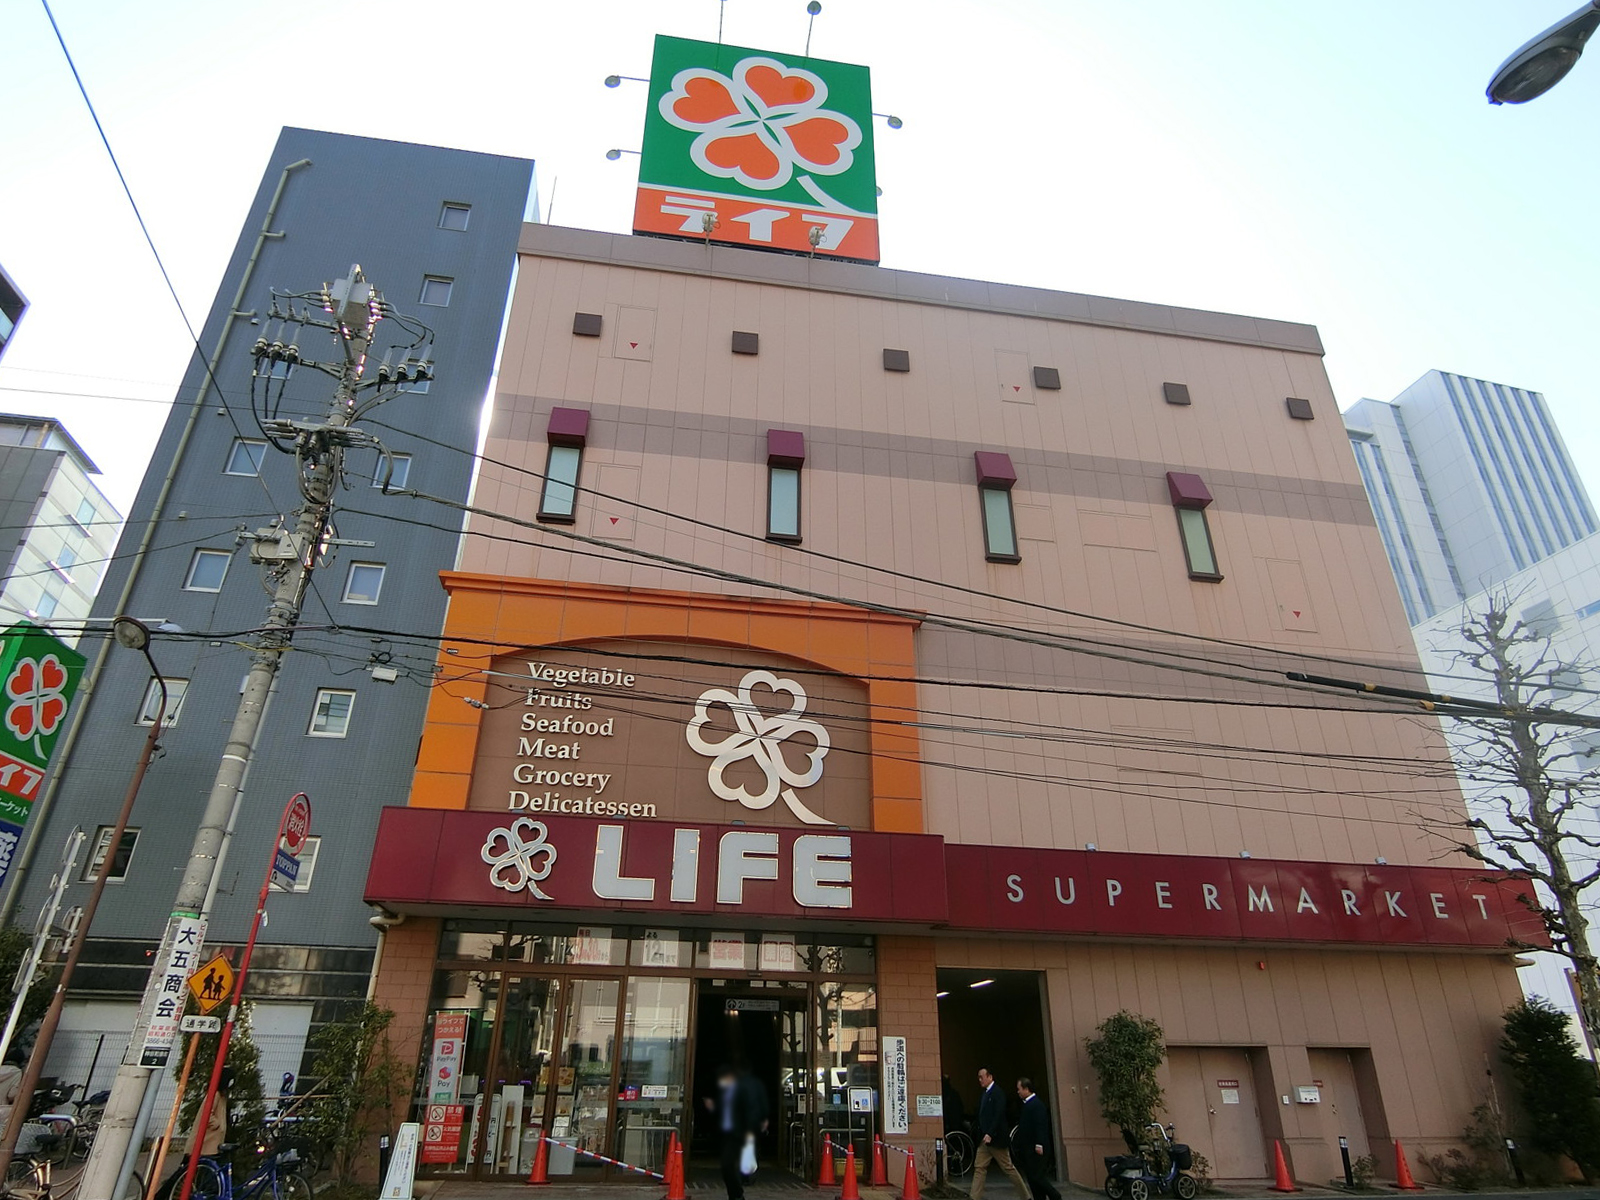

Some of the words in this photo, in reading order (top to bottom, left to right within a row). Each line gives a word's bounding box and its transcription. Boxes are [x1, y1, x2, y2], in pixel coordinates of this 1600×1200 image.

[660, 195, 855, 251] ライフ
[527, 661, 636, 687] Vegetable
[524, 687, 592, 710] Fruits
[520, 712, 614, 736] Seafood
[516, 736, 581, 760] Meat
[513, 763, 612, 794] Grocery
[508, 790, 657, 817] Delicatessen
[591, 823, 853, 909] LIFE
[1006, 874, 1489, 920] SUPERMARKET
[155, 926, 197, 1018] 大五商会
[436, 1055, 457, 1063] PayPay
[437, 1080, 451, 1088] Pay
